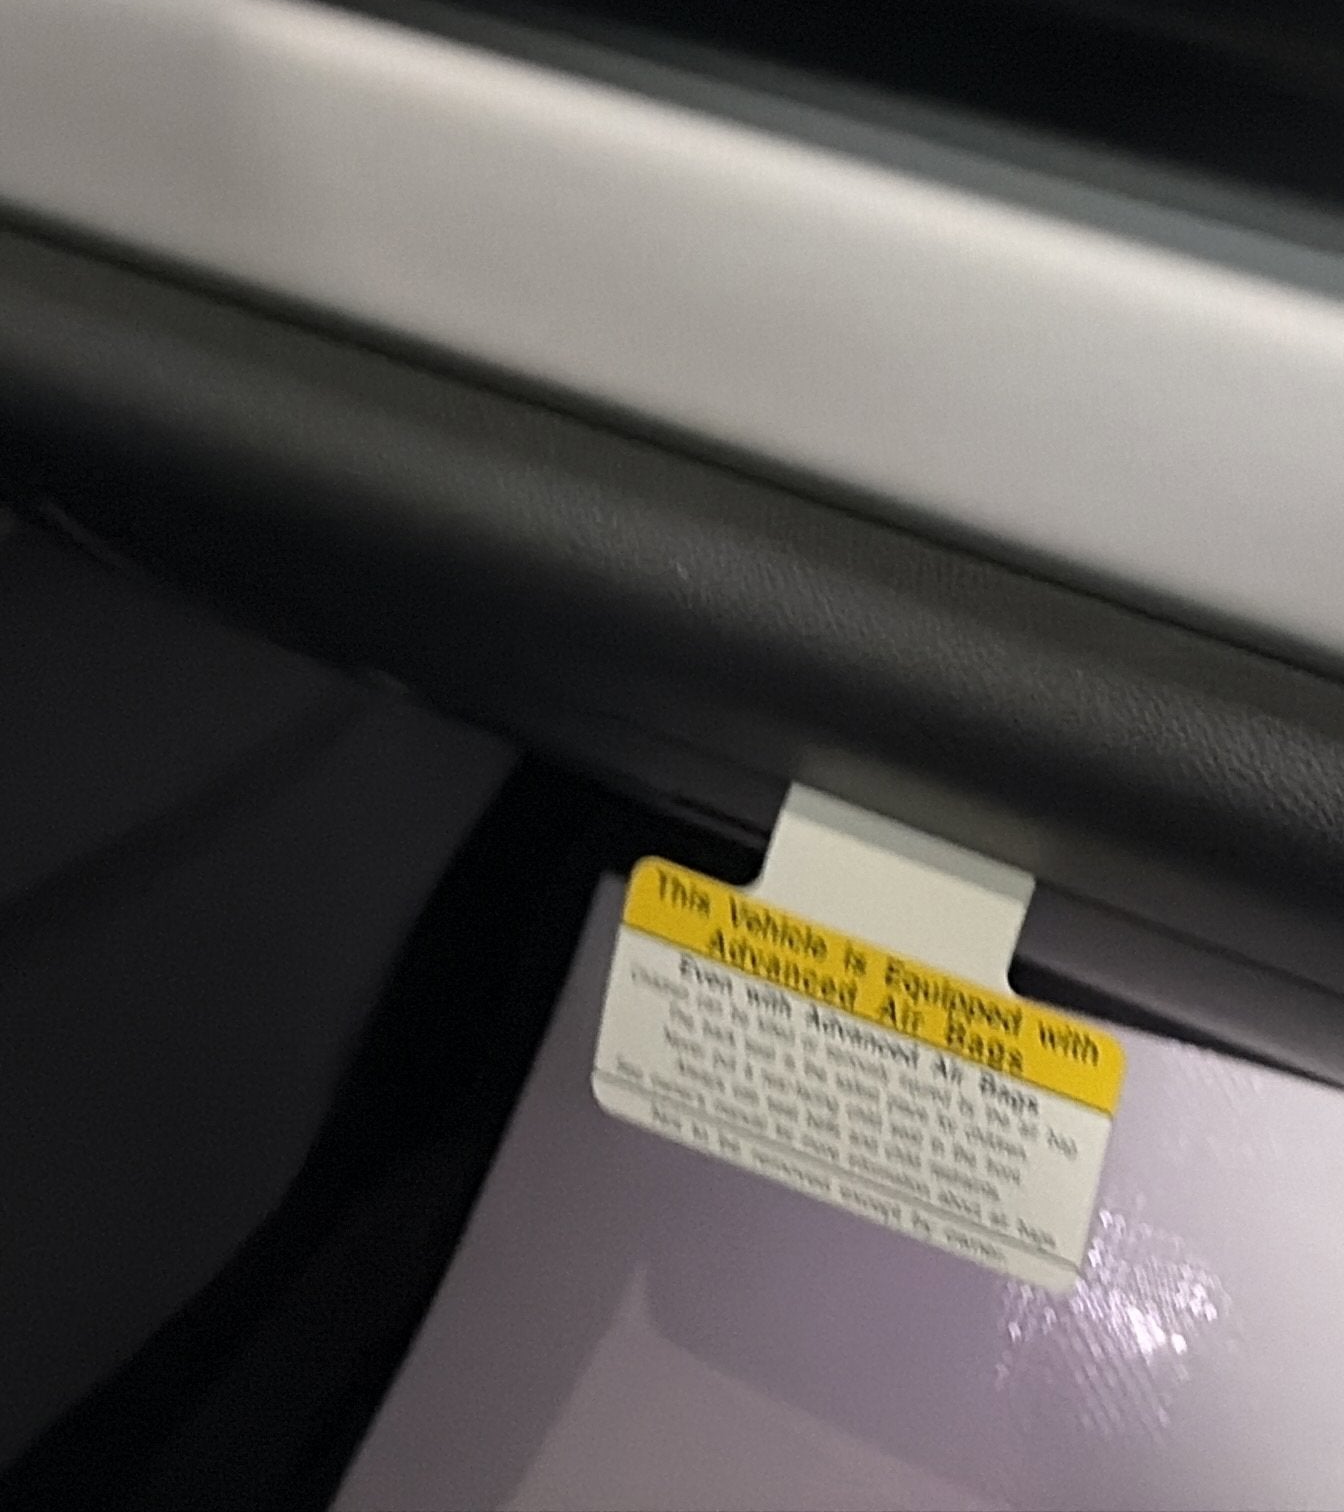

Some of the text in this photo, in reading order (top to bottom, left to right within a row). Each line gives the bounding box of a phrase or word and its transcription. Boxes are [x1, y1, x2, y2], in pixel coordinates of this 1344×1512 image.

[657, 868, 711, 919] This
[728, 893, 828, 964] Vehicle
[842, 939, 867, 977] is
[885, 956, 1023, 1038] Equipped
[1038, 1019, 1100, 1068] with
[678, 951, 734, 996] Even
[744, 982, 793, 1022] with
[805, 1001, 920, 1071] Advanced
[929, 1053, 964, 1090] Air
[977, 1070, 1040, 1117] Bags
[709, 926, 858, 1014] Advanced
[879, 994, 924, 1036] Air
[945, 1014, 1025, 1078] Bags
